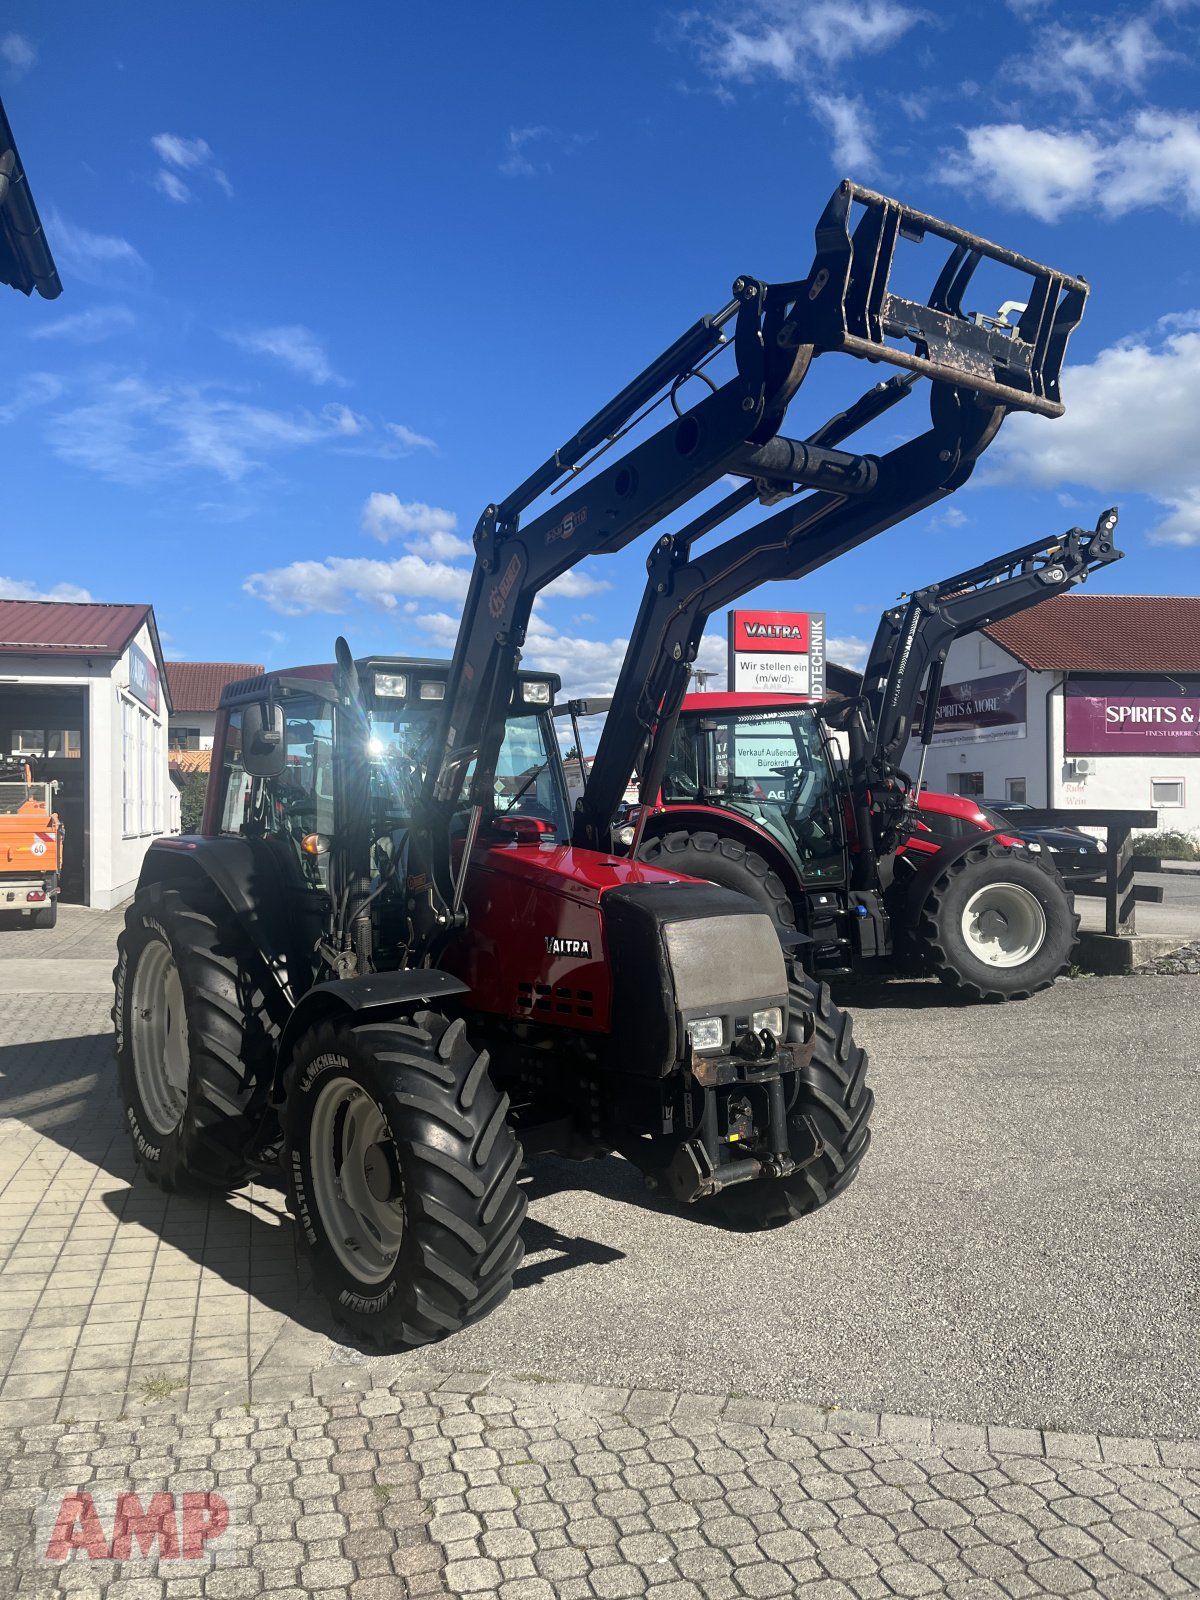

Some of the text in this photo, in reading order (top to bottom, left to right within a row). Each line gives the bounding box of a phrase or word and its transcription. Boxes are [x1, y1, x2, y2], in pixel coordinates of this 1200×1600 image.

[744, 622, 802, 639] VALTRA
[740, 661, 757, 670] Wir
[760, 662, 791, 671] stellen
[755, 673, 794, 684] (m/w/d):
[935, 697, 1001, 719] SPIRITS & MORE
[1106, 705, 1195, 723] SPIRITS &
[738, 748, 764, 756] Verkauf
[766, 748, 800, 757] Außendie
[757, 758, 789, 767] Bürokraft
[1066, 797, 1087, 805] Wein
[34, 845, 44, 854] 60
[544, 936, 590, 955] VALTRA
[306, 1053, 349, 1078] MICHELIN
[291, 1150, 318, 1246] MULTIBIB
